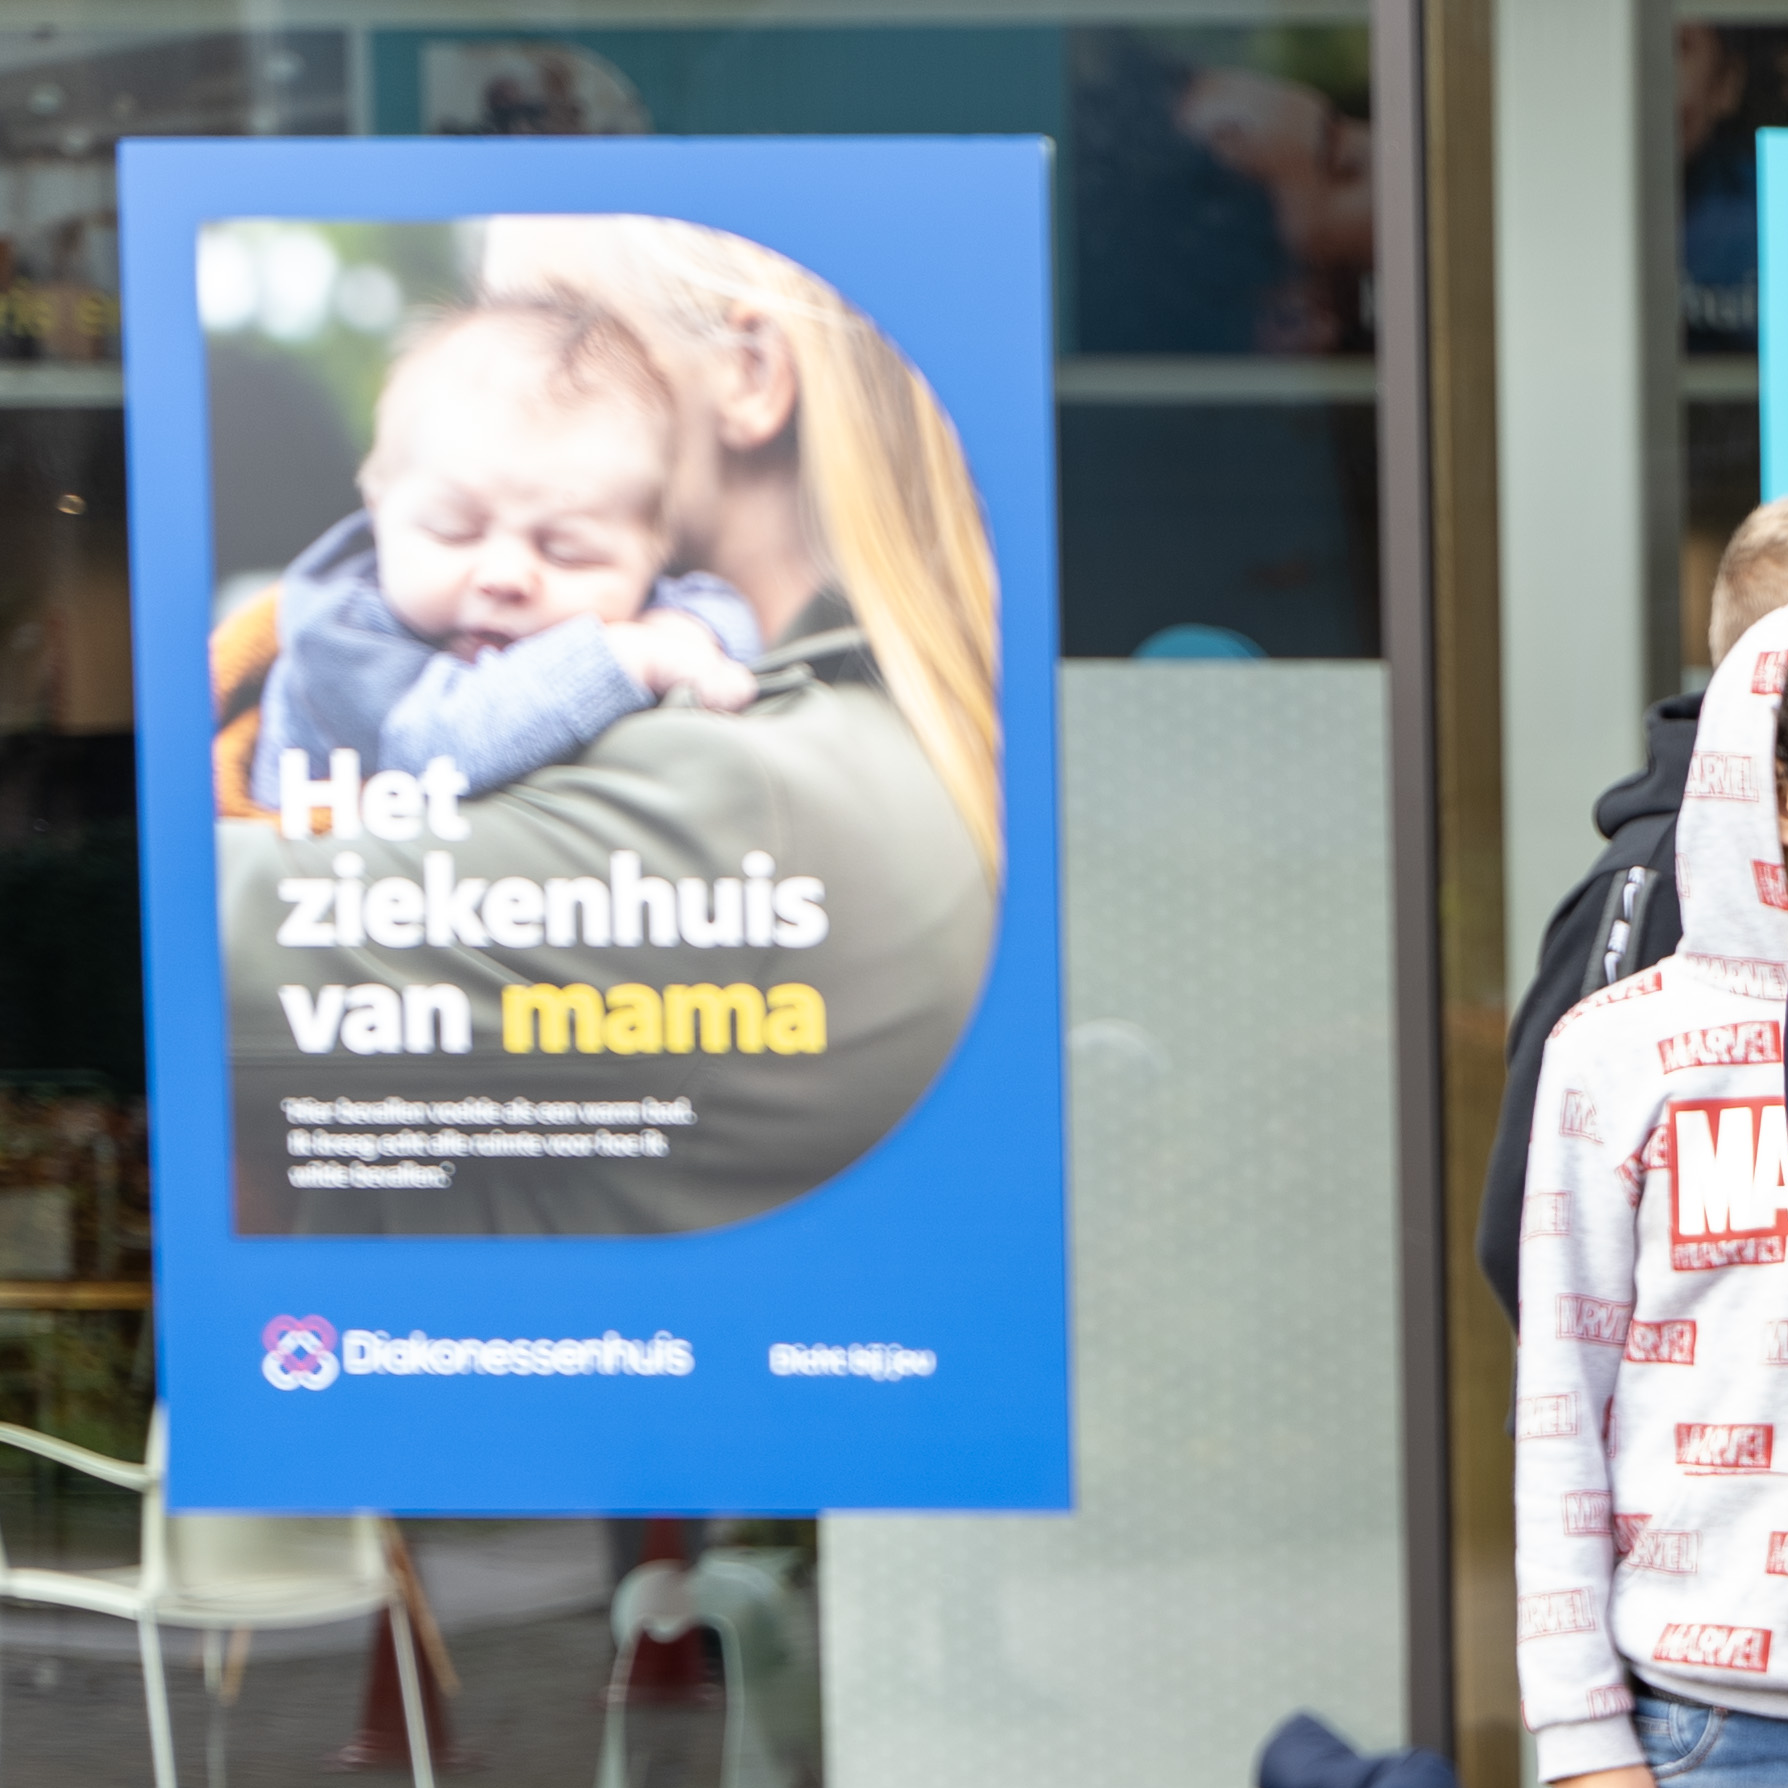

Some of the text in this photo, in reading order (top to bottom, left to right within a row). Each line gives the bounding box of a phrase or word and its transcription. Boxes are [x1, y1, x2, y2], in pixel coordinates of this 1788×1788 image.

[279, 747, 471, 841] Het
[277, 849, 830, 948] ziekenhuis
[278, 982, 828, 1054] van mama
[1660, 1021, 1780, 1070] MARVEL
[343, 1328, 696, 1378] Diakonessenhuis
[1656, 1624, 1769, 1670] MARVEL
